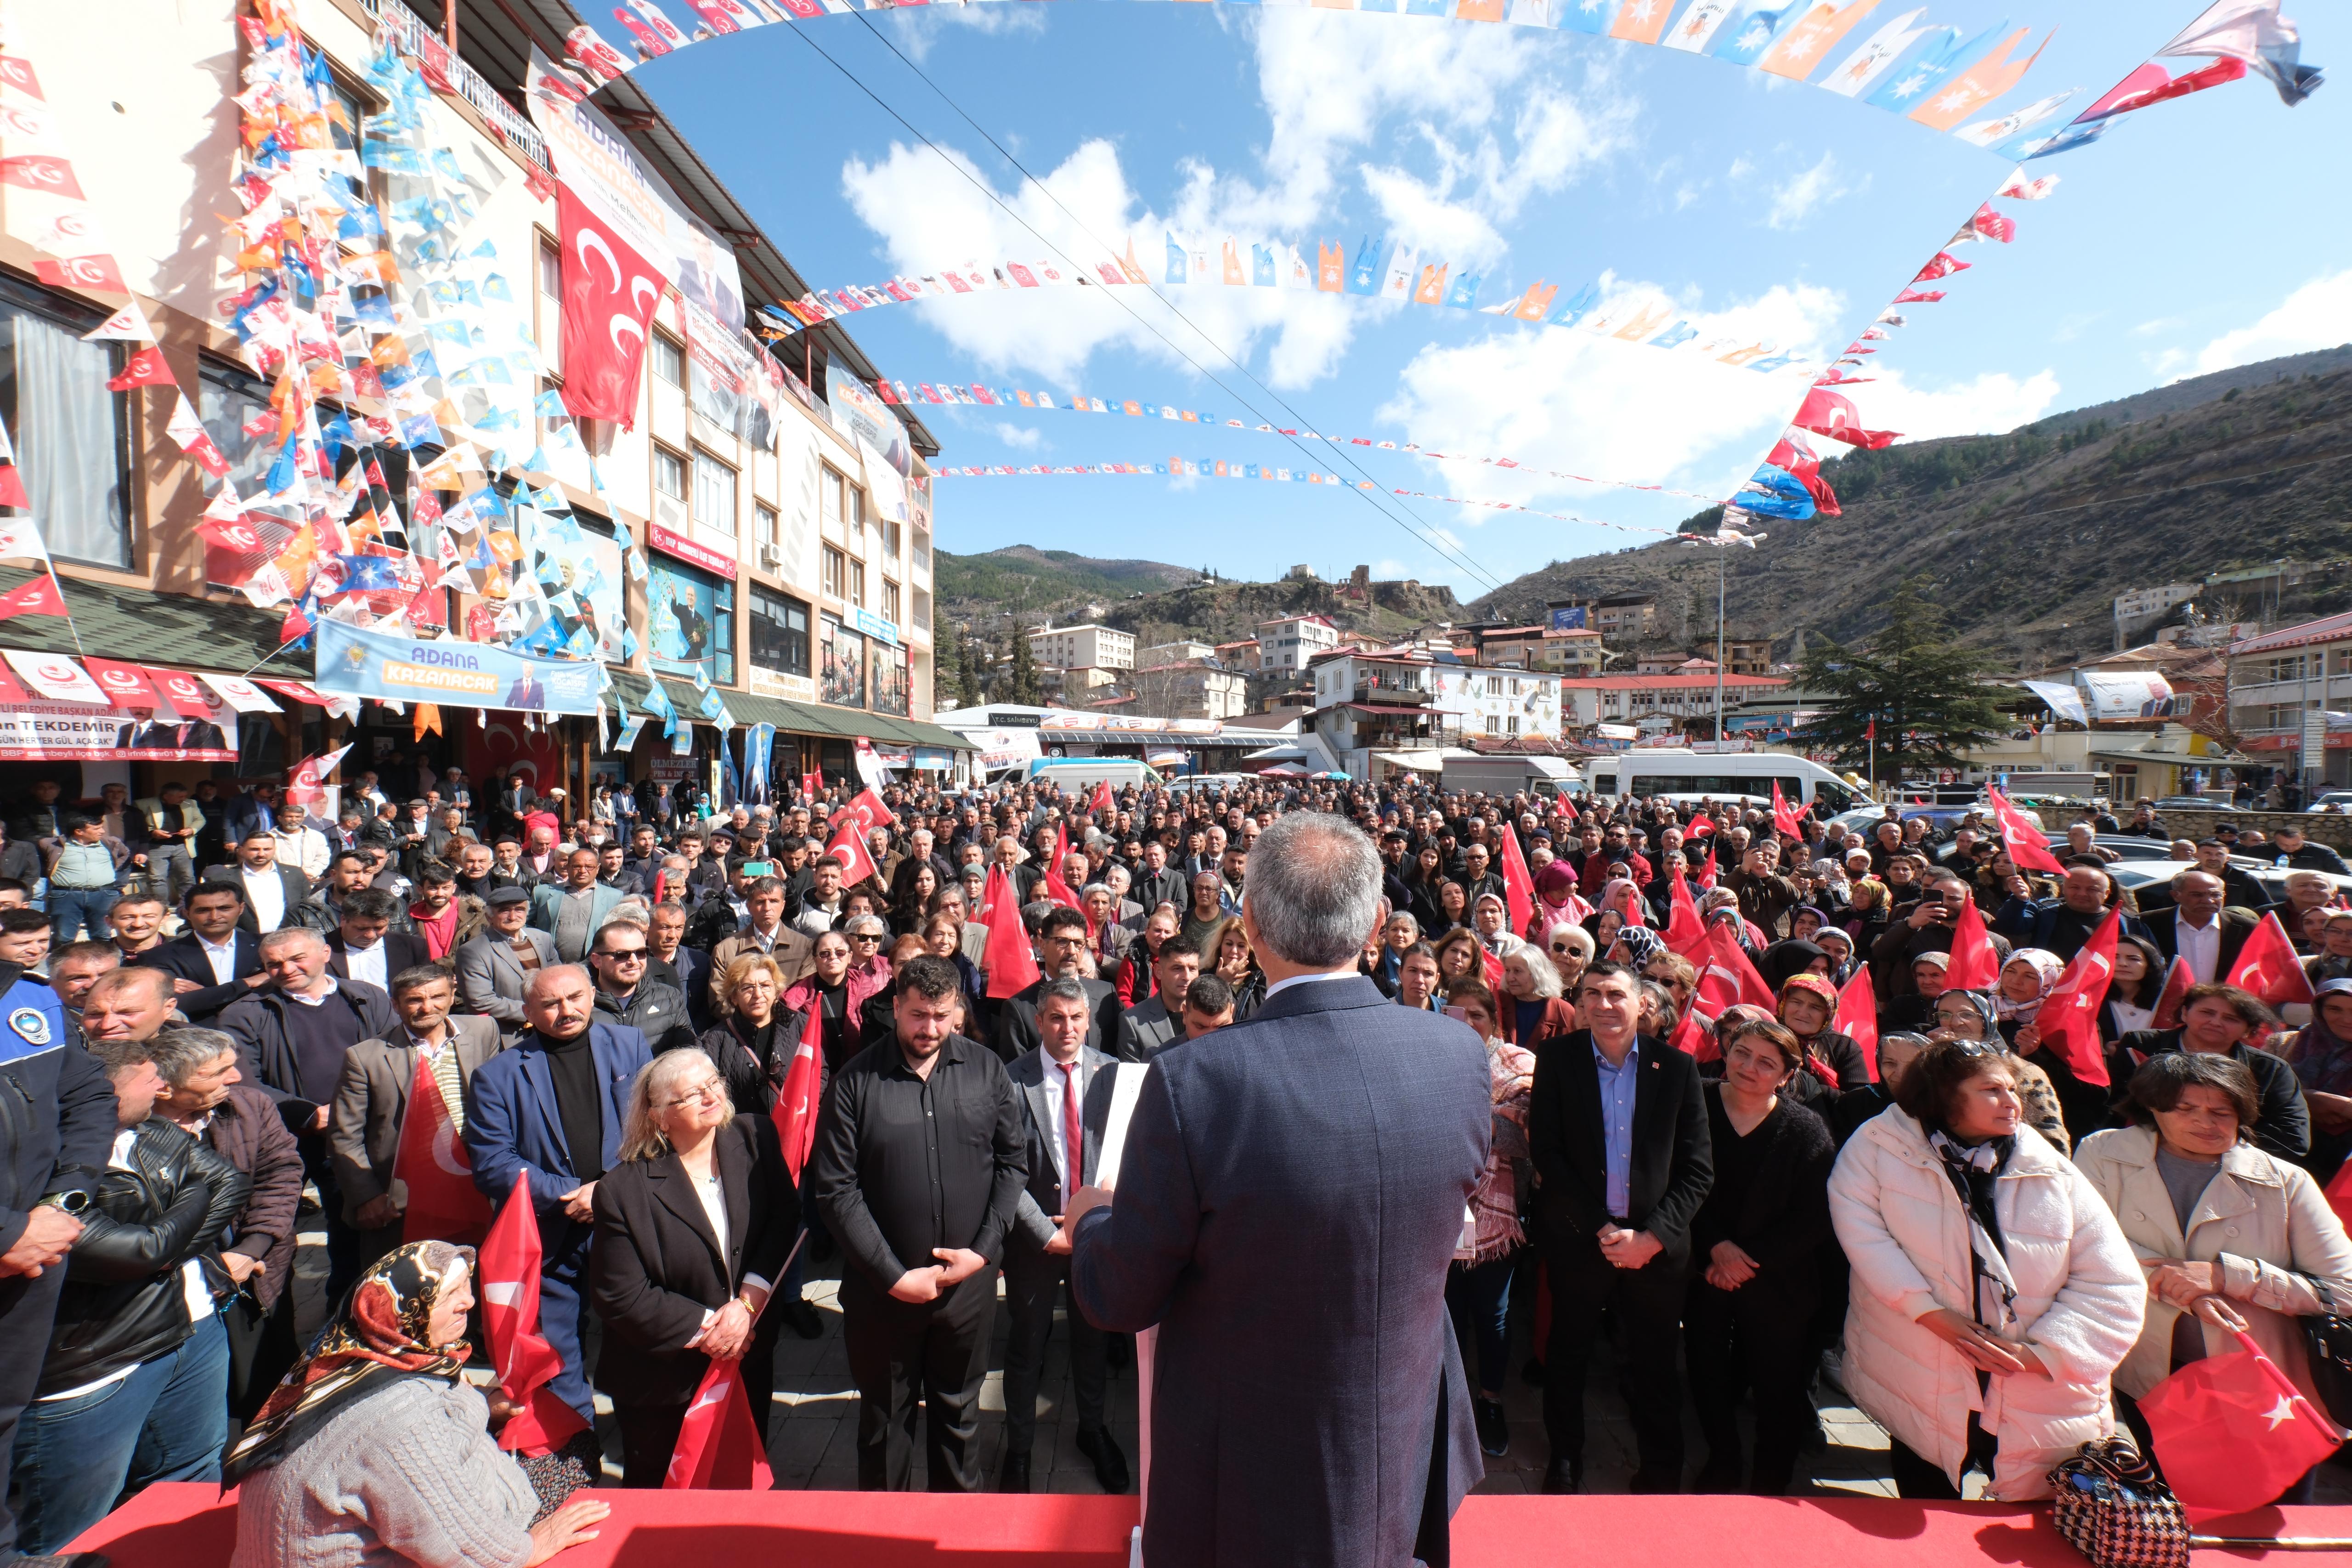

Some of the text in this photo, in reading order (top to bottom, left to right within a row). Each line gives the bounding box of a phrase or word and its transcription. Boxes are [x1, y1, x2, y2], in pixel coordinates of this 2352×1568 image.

[575, 105, 644, 188] ADANA
[611, 193, 648, 234] Mehmet
[694, 343, 714, 365] VEDAT
[714, 362, 736, 386] CENGİZ
[412, 647, 479, 670] ADANA
[387, 665, 494, 691] KAZANACAK
[12, 706, 55, 714] BELEDİYE
[59, 707, 93, 717] BAŞKAN
[95, 709, 119, 717] ADAYI
[19, 720, 115, 732] TEKDEMİR
[76, 750, 91, 758] ilçe
[650, 756, 697, 769] ÖLMEZLER
